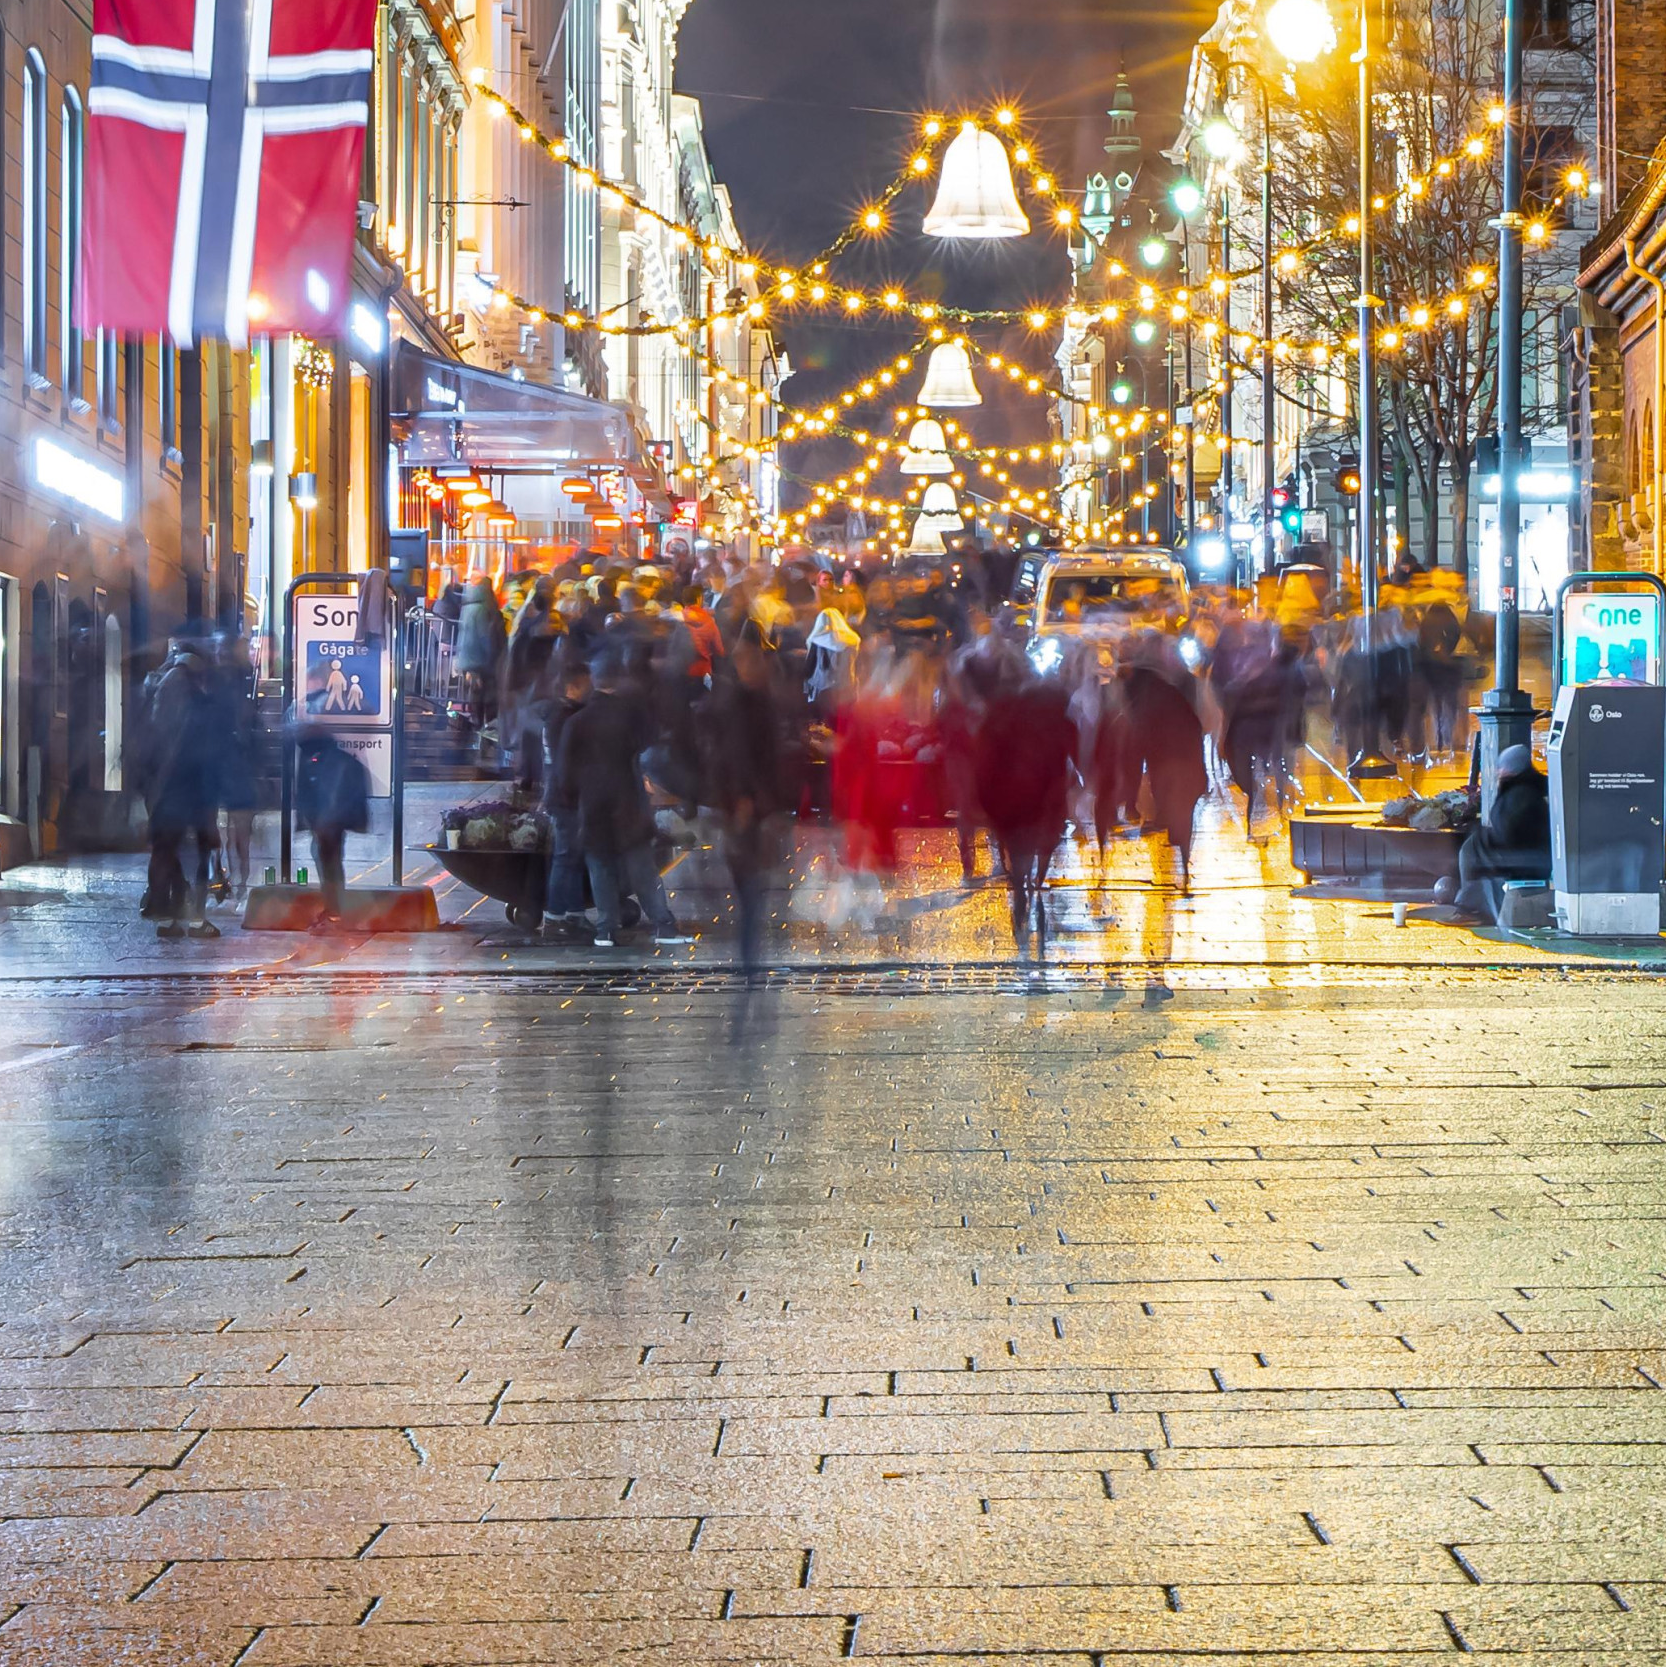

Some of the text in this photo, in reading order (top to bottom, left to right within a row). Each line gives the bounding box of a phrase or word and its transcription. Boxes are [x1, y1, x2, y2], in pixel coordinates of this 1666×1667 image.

[318, 642, 369, 659] Gågate
[1605, 710, 1623, 718] Oslo
[337, 739, 382, 750] ansport
